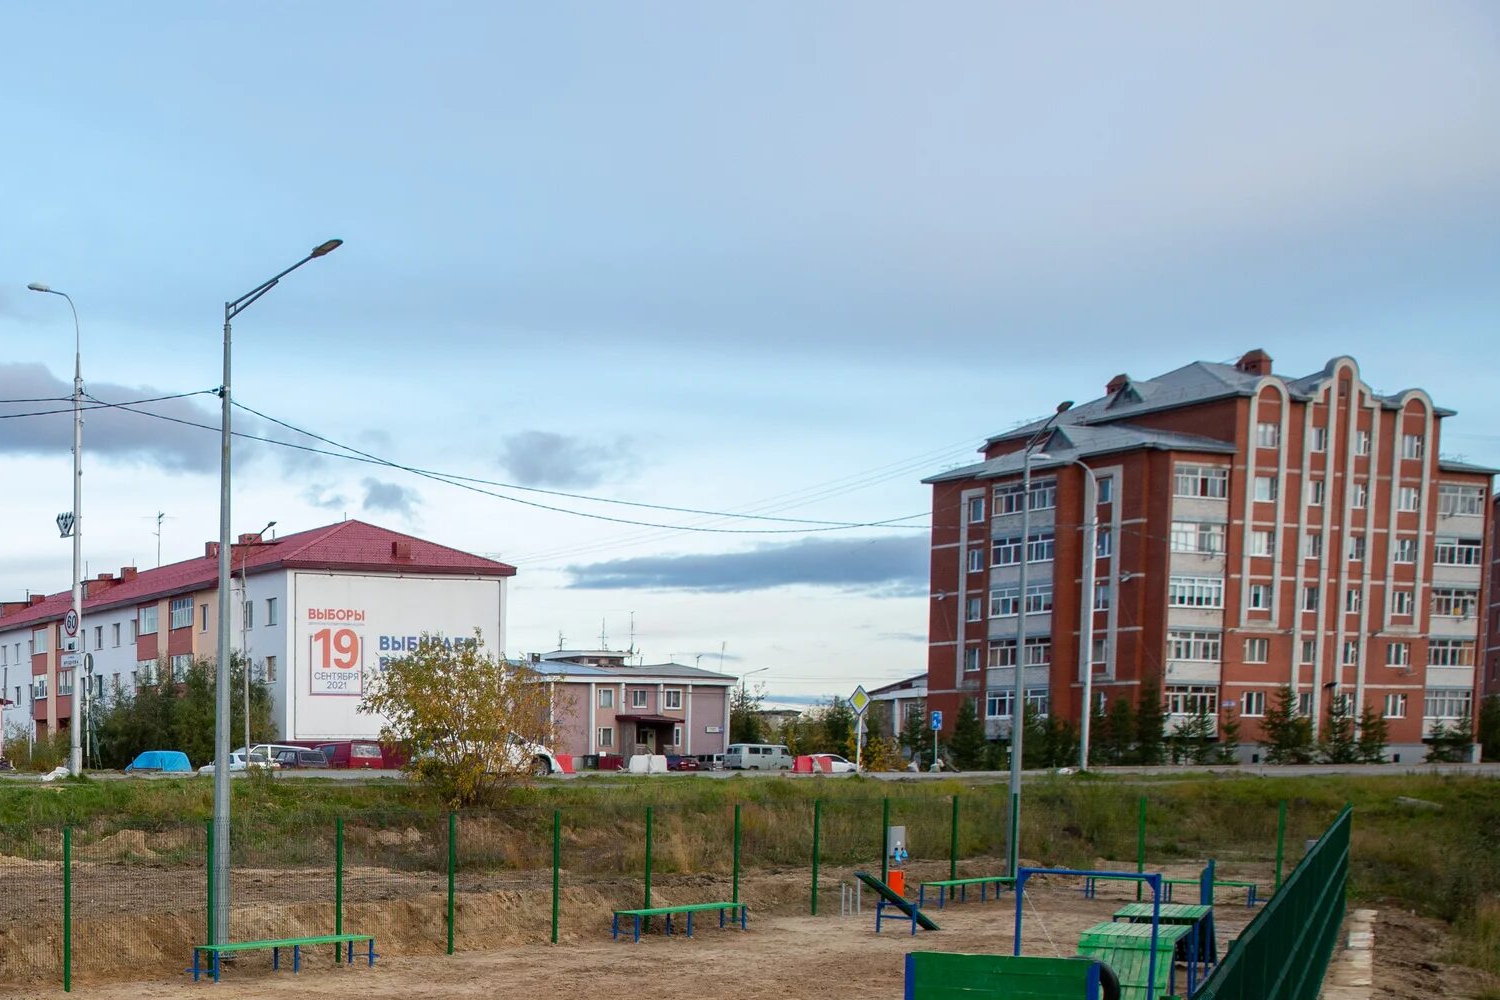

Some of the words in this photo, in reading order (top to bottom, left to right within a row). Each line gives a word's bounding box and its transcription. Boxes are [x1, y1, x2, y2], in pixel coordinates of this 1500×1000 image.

[308, 608, 365, 621] ВЫБОРЫ
[67, 615, 77, 629] 60
[314, 628, 359, 669] 19
[314, 672, 360, 681] СЕНТЯБРЯ
[326, 681, 347, 690] 2021
